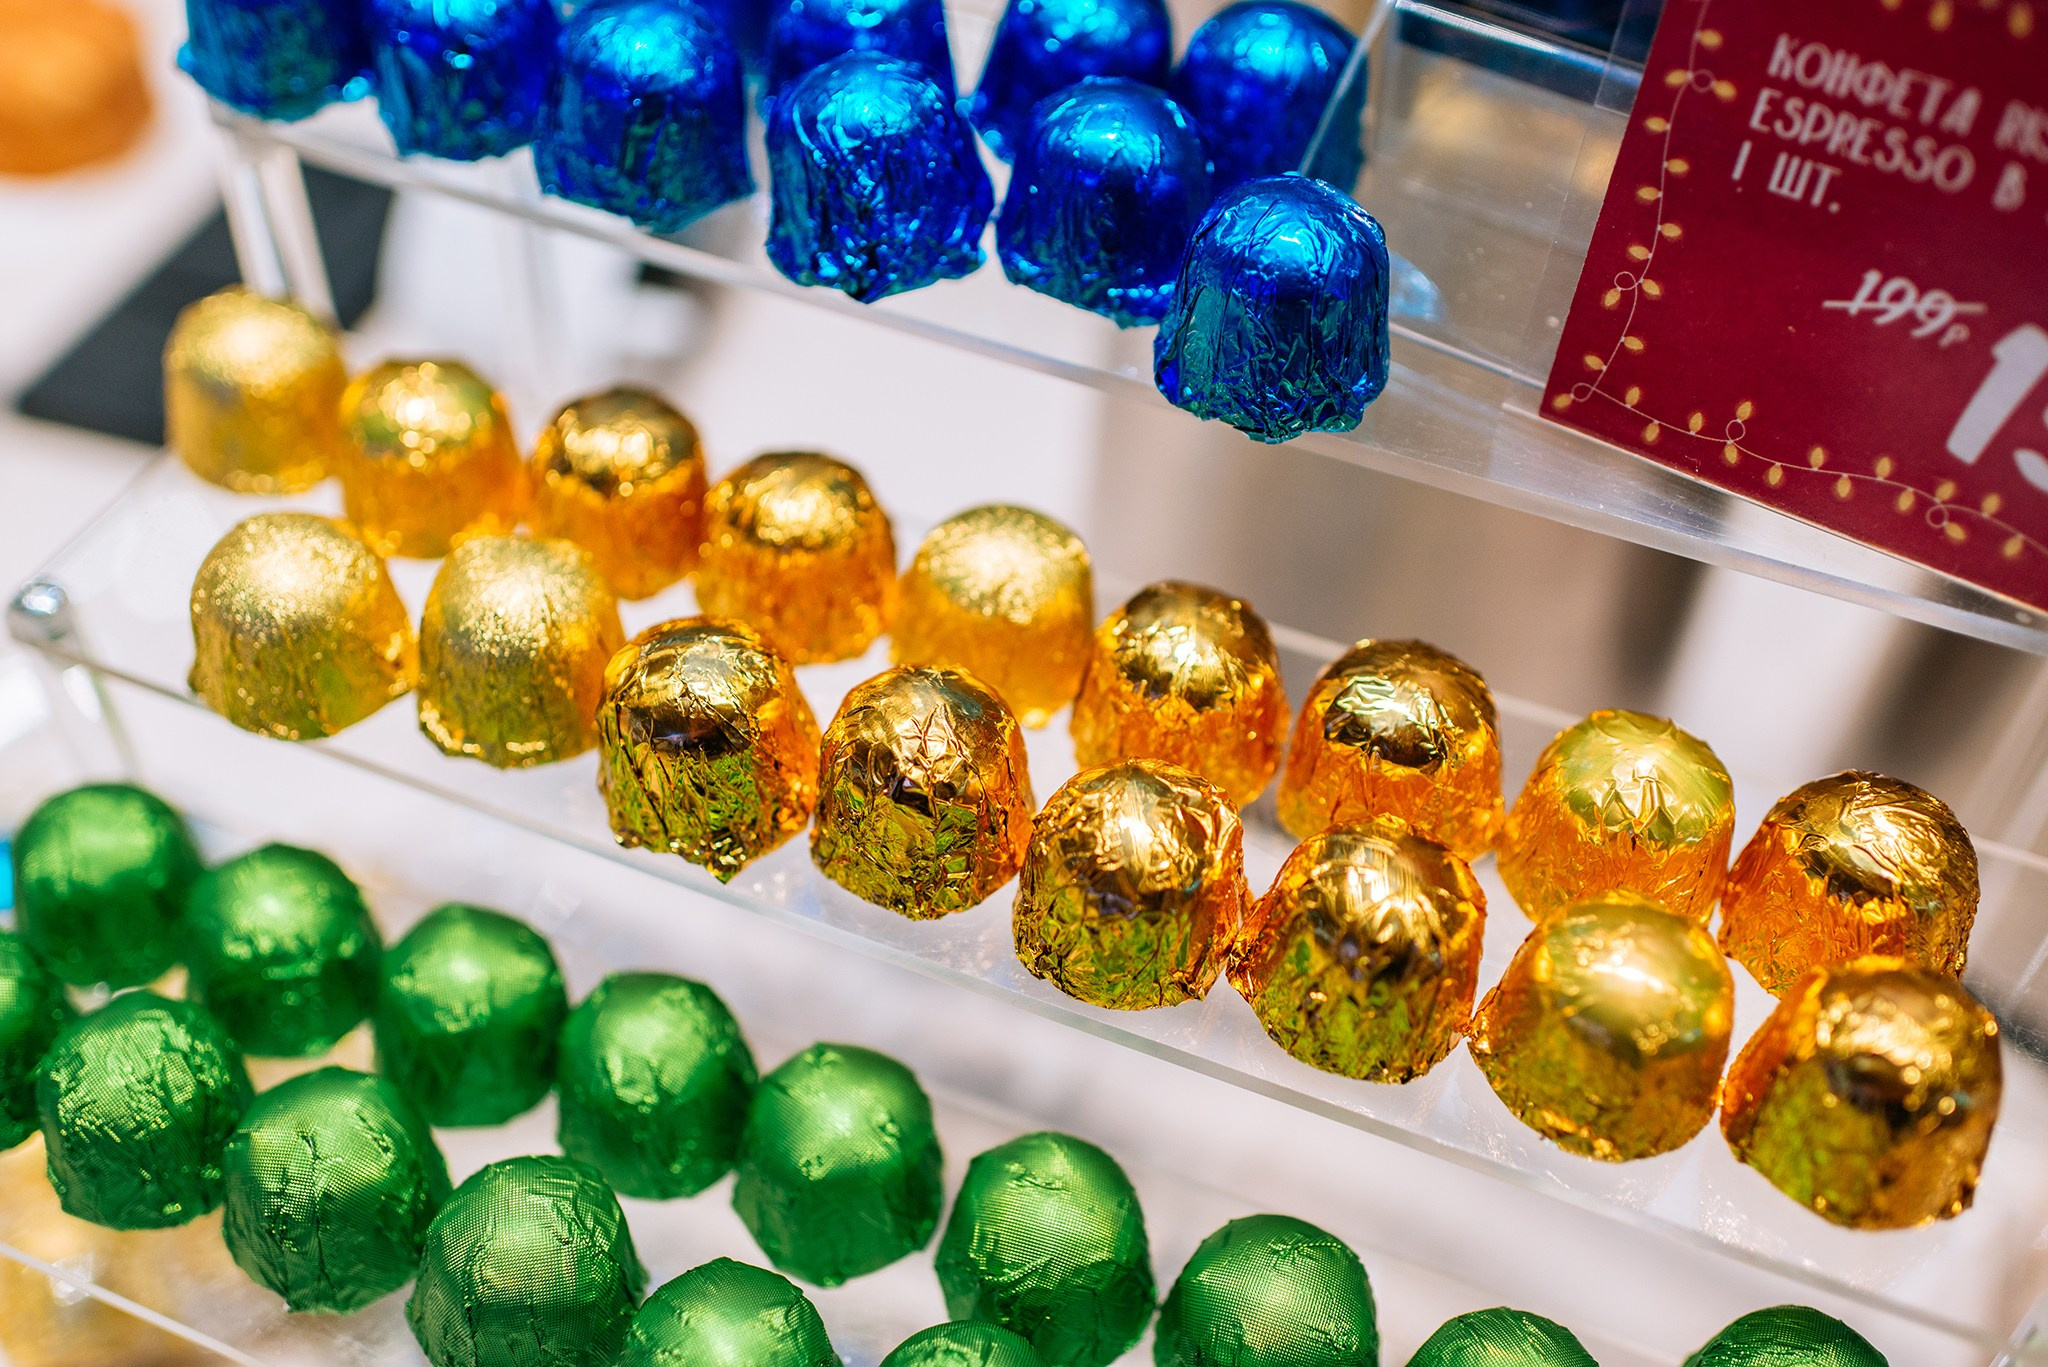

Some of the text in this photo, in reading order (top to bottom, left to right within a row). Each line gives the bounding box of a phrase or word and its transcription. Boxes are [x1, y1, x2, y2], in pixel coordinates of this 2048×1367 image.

[1767, 33, 1982, 137] КОНФЕТА
[1749, 87, 1976, 193] ESPRESSO
[1768, 151, 1843, 214] ШТ.
